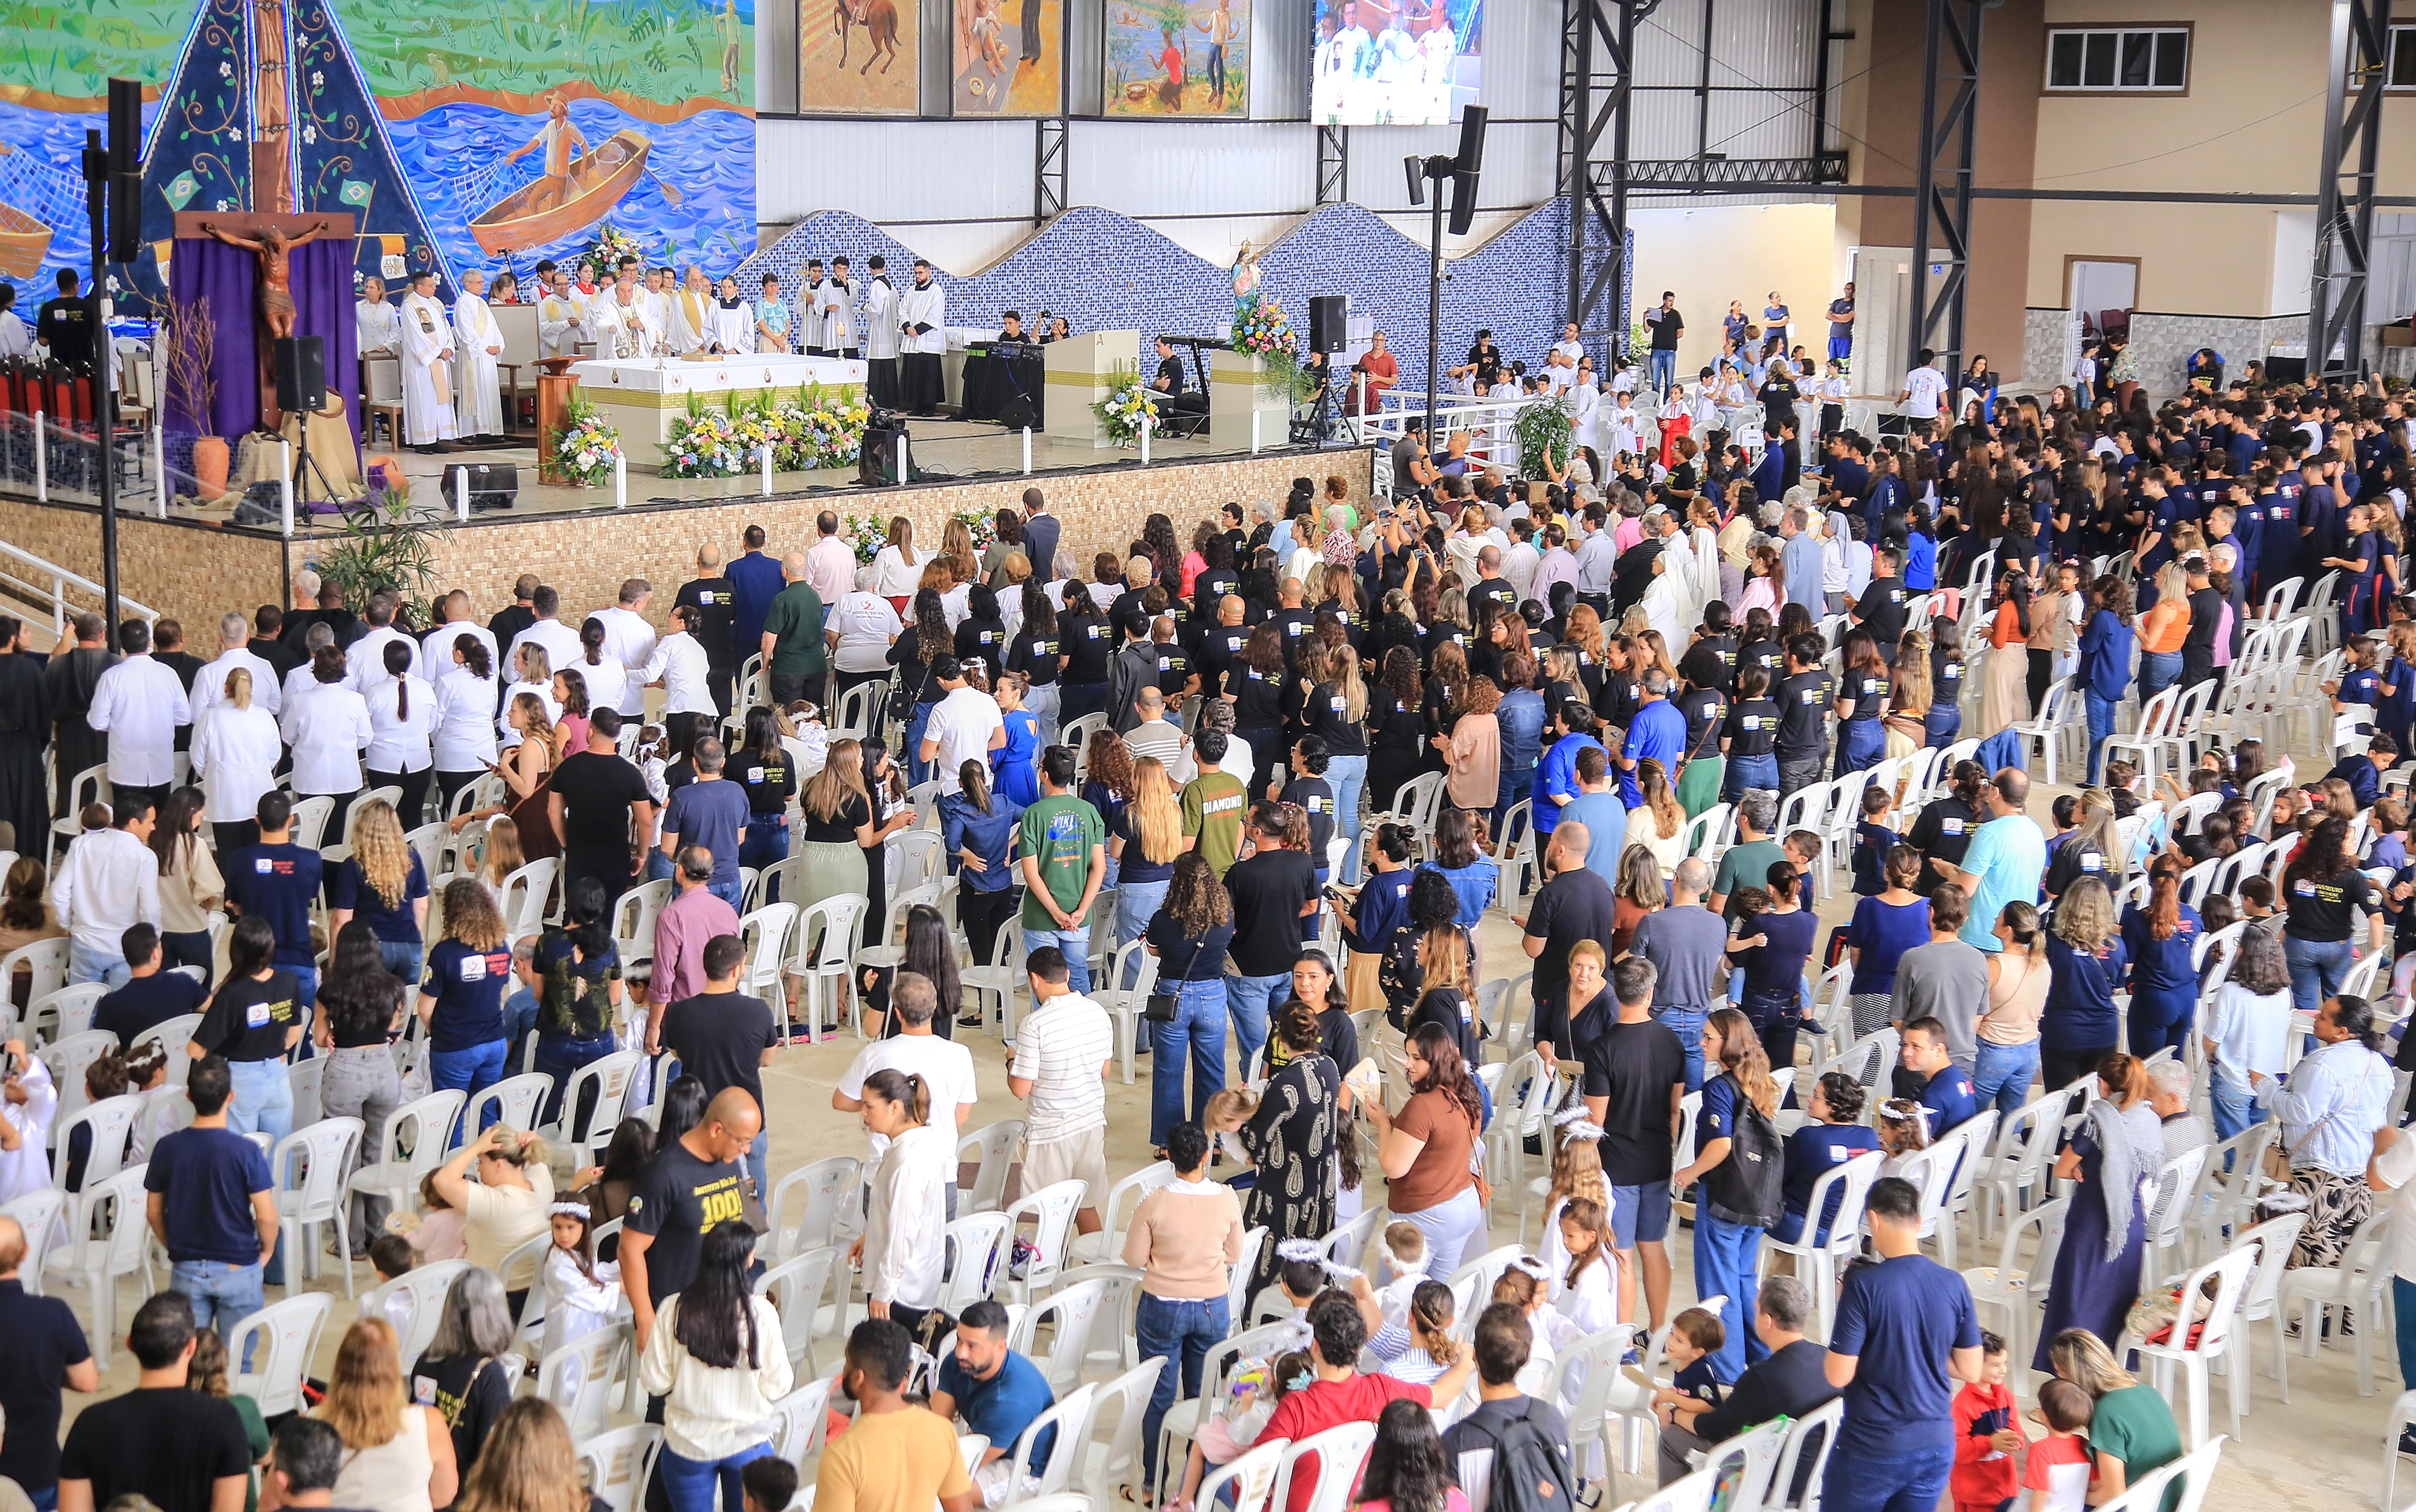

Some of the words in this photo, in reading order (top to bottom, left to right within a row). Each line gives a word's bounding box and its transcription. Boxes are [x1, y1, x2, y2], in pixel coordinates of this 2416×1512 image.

[1203, 795, 1242, 815] DIAMOND
[1053, 814, 1077, 829] NIKE
[701, 1190, 738, 1225] 100
